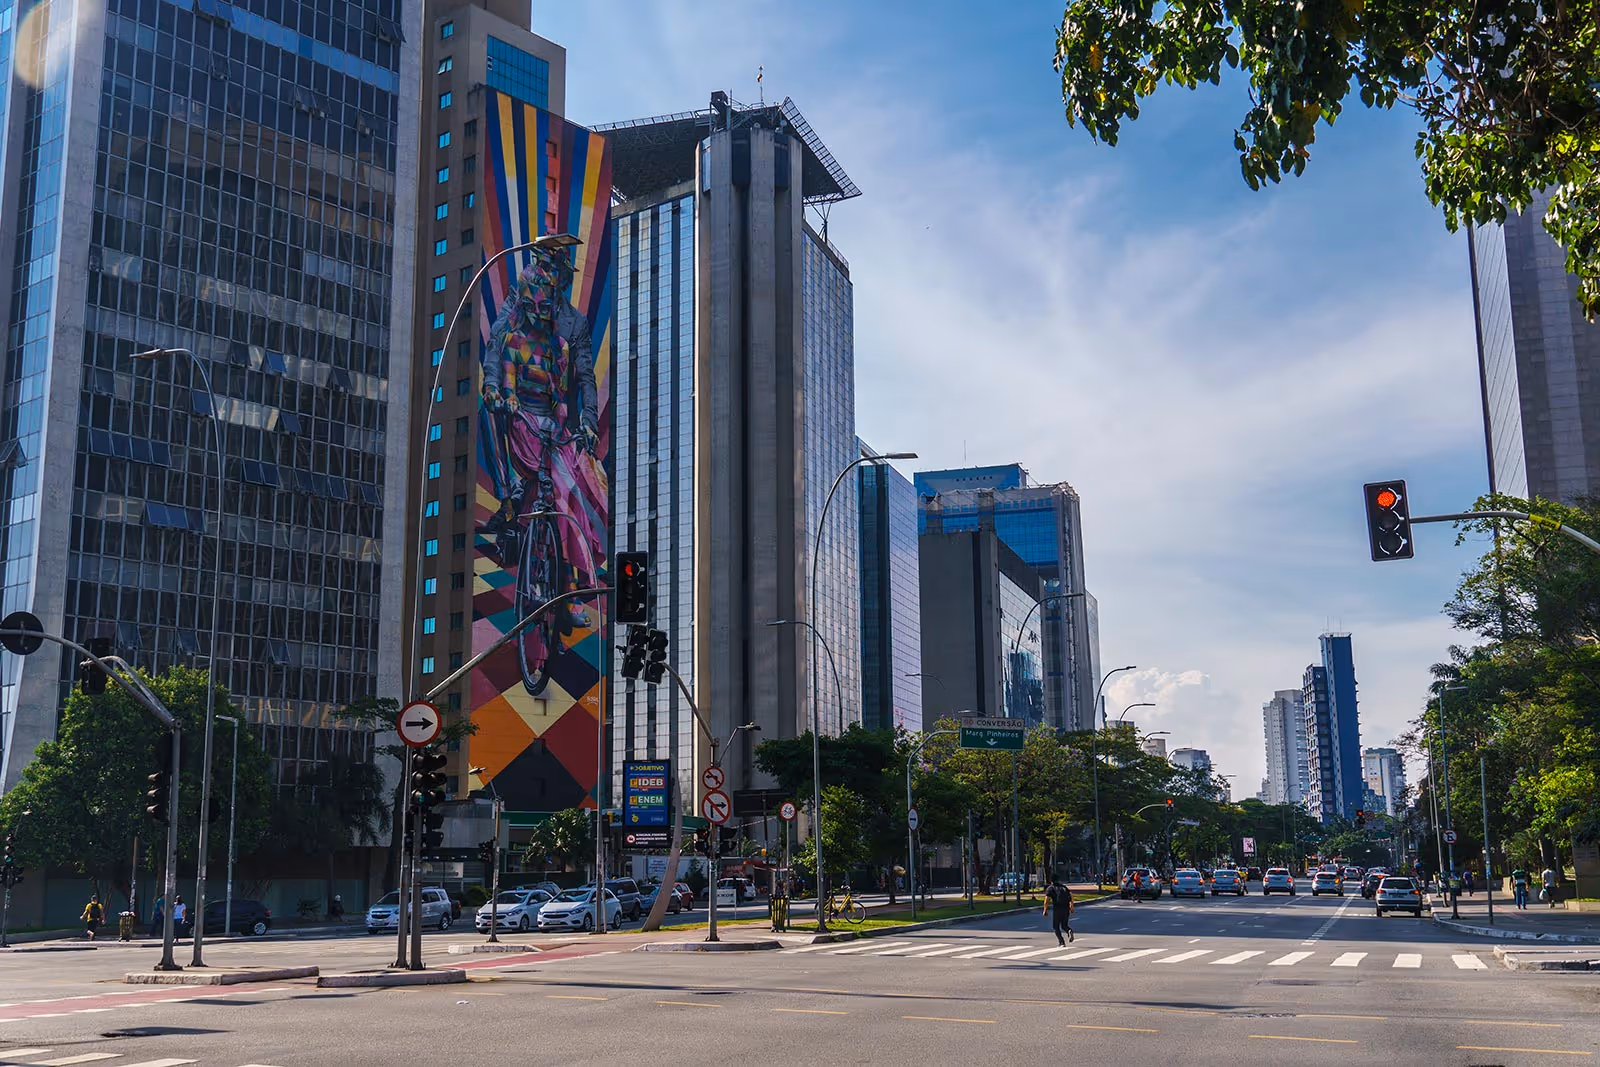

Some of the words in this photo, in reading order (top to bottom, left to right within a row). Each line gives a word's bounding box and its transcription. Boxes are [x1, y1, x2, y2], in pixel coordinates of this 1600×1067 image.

[986, 730, 1019, 738] Pinheiros
[638, 778, 664, 786] IDEB
[638, 796, 663, 804] ENEM
